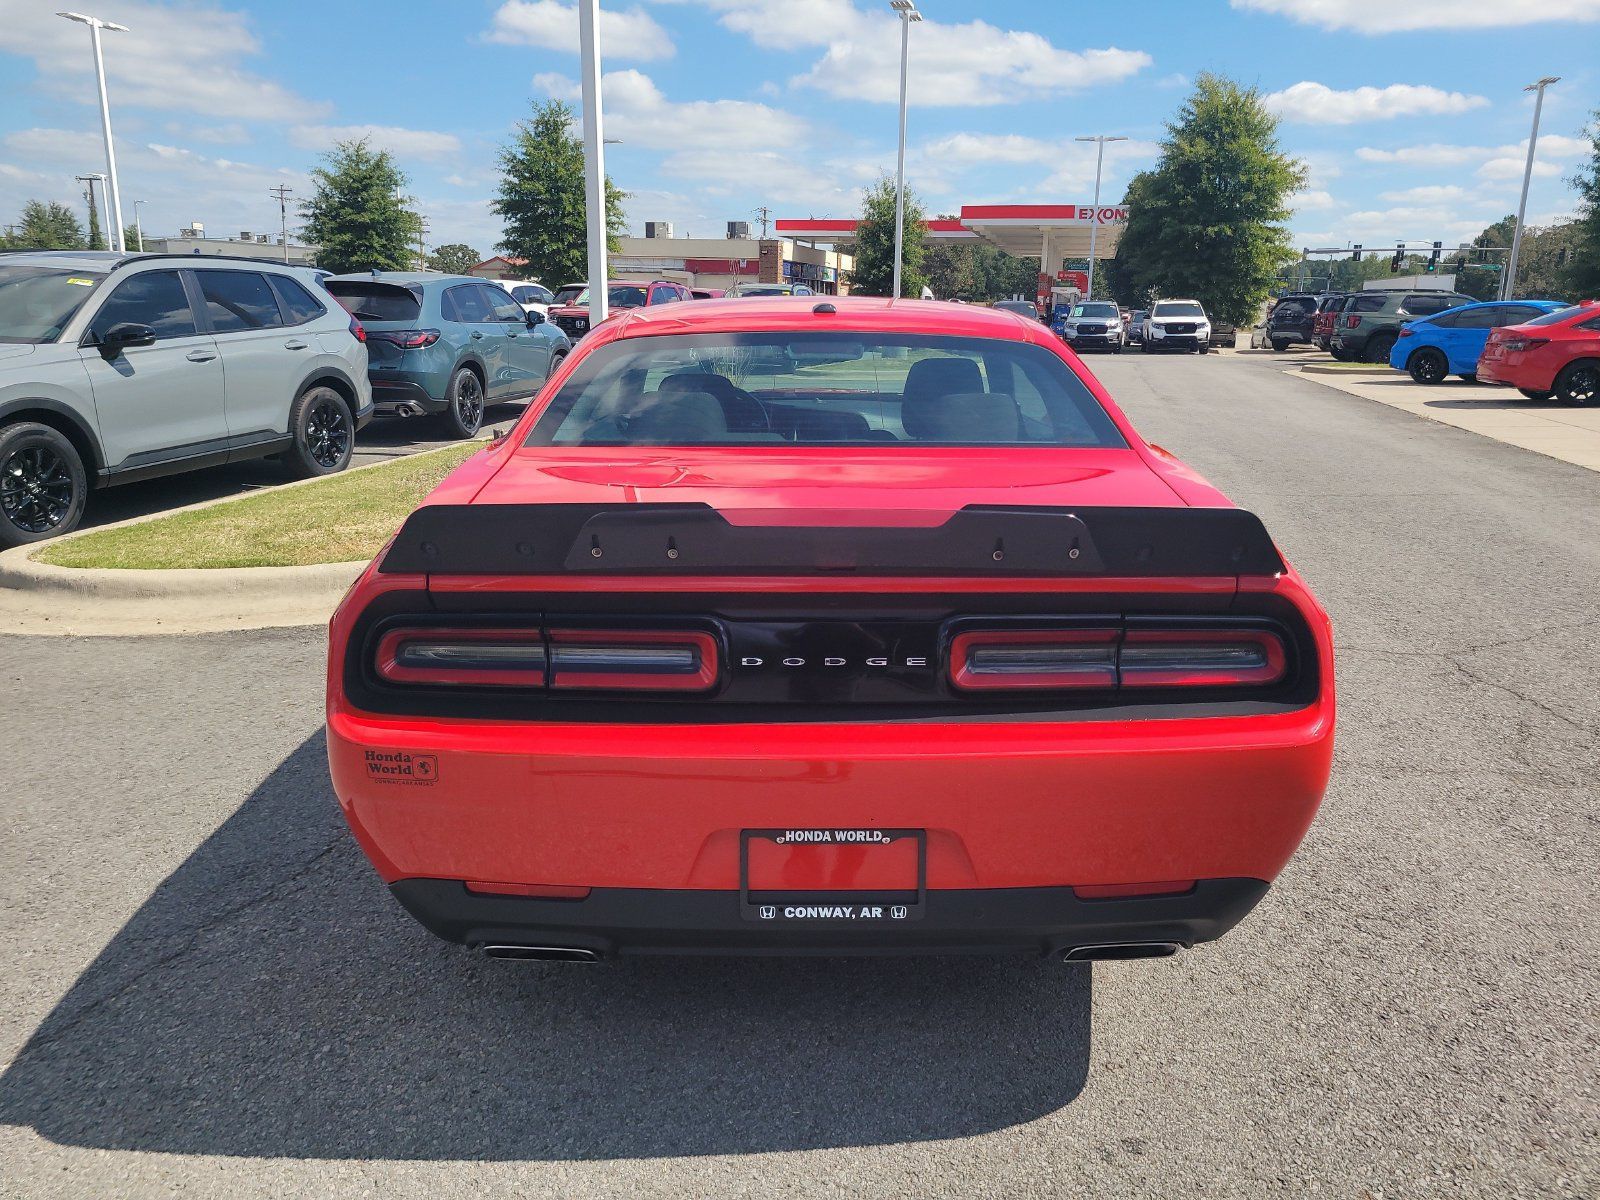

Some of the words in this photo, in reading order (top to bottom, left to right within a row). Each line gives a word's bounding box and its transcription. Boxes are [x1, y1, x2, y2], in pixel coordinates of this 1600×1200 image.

[741, 657, 927, 666] DODGE
[365, 751, 412, 763] Honda
[368, 763, 412, 775] World
[785, 830, 832, 842] HONDA
[834, 830, 883, 842] WORLD
[784, 906, 856, 919] CONWAY,
[860, 906, 882, 918] AR
